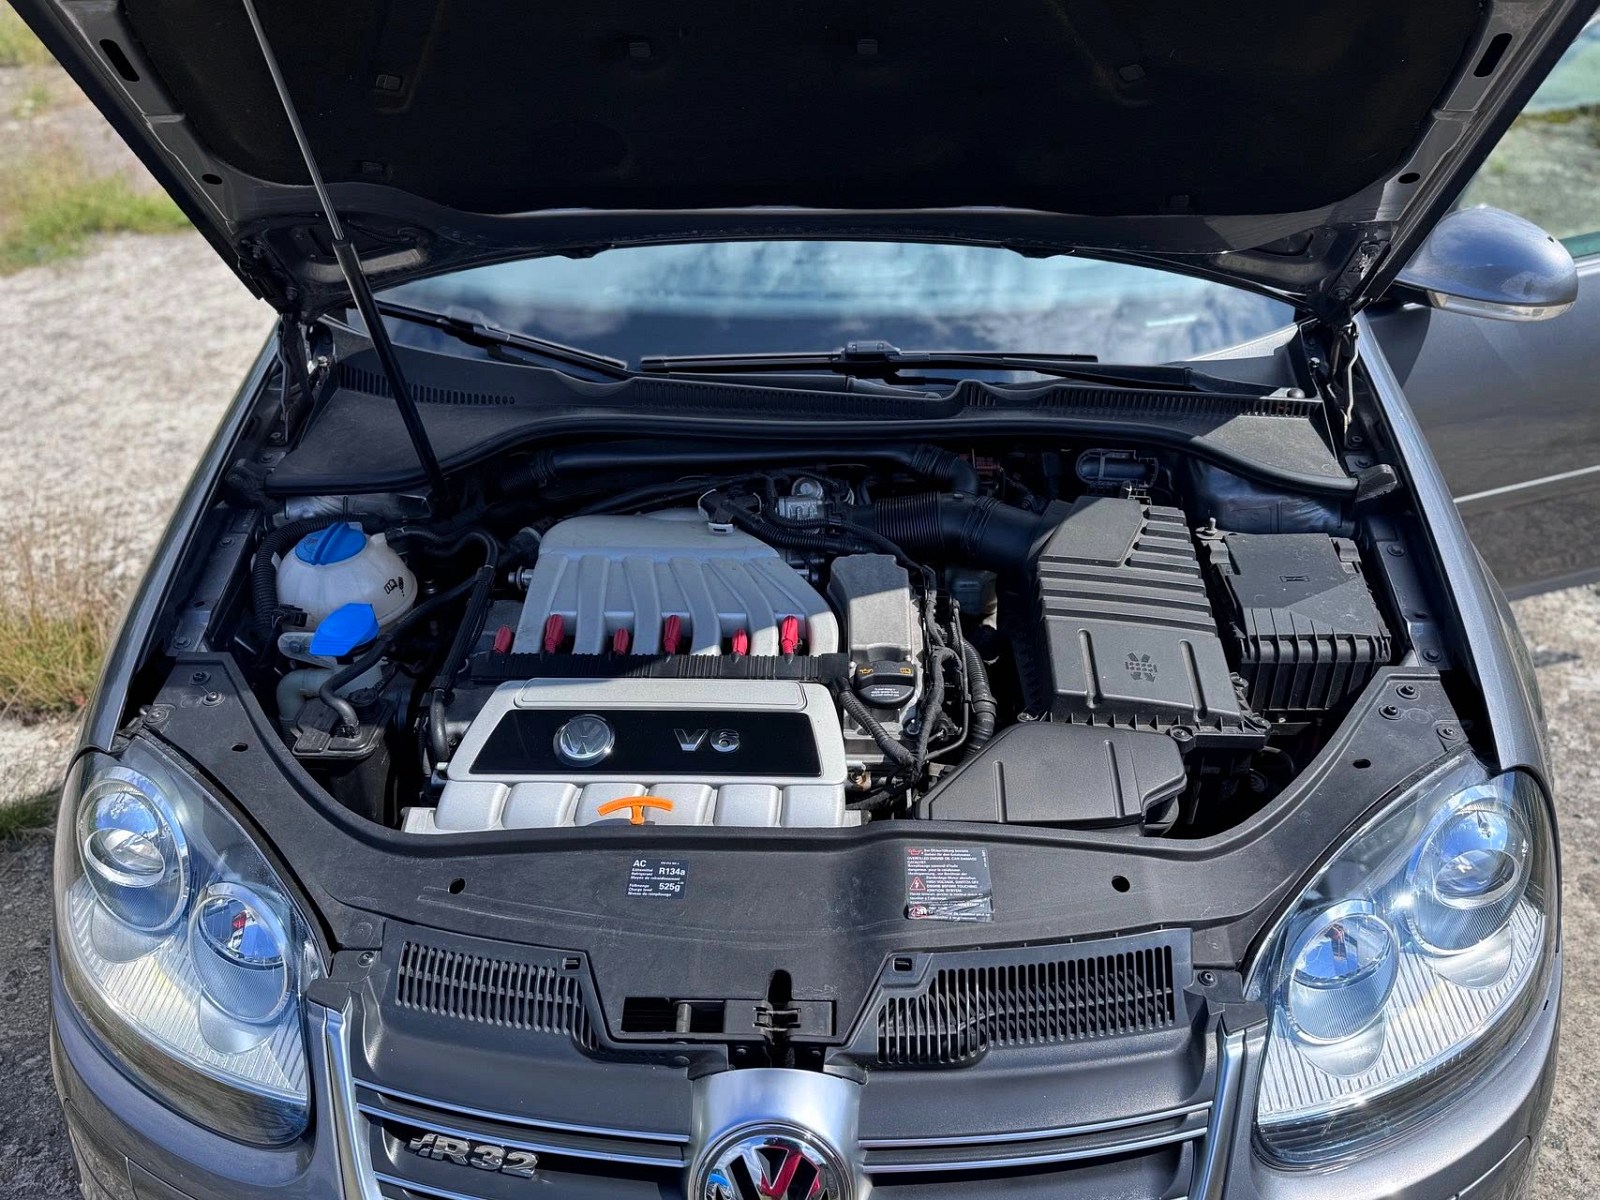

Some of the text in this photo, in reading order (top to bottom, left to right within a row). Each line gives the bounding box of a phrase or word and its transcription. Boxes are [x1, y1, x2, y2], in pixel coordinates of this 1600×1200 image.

[674, 728, 740, 752] V6
[659, 867, 686, 876] R134a
[659, 883, 681, 892] 525g
